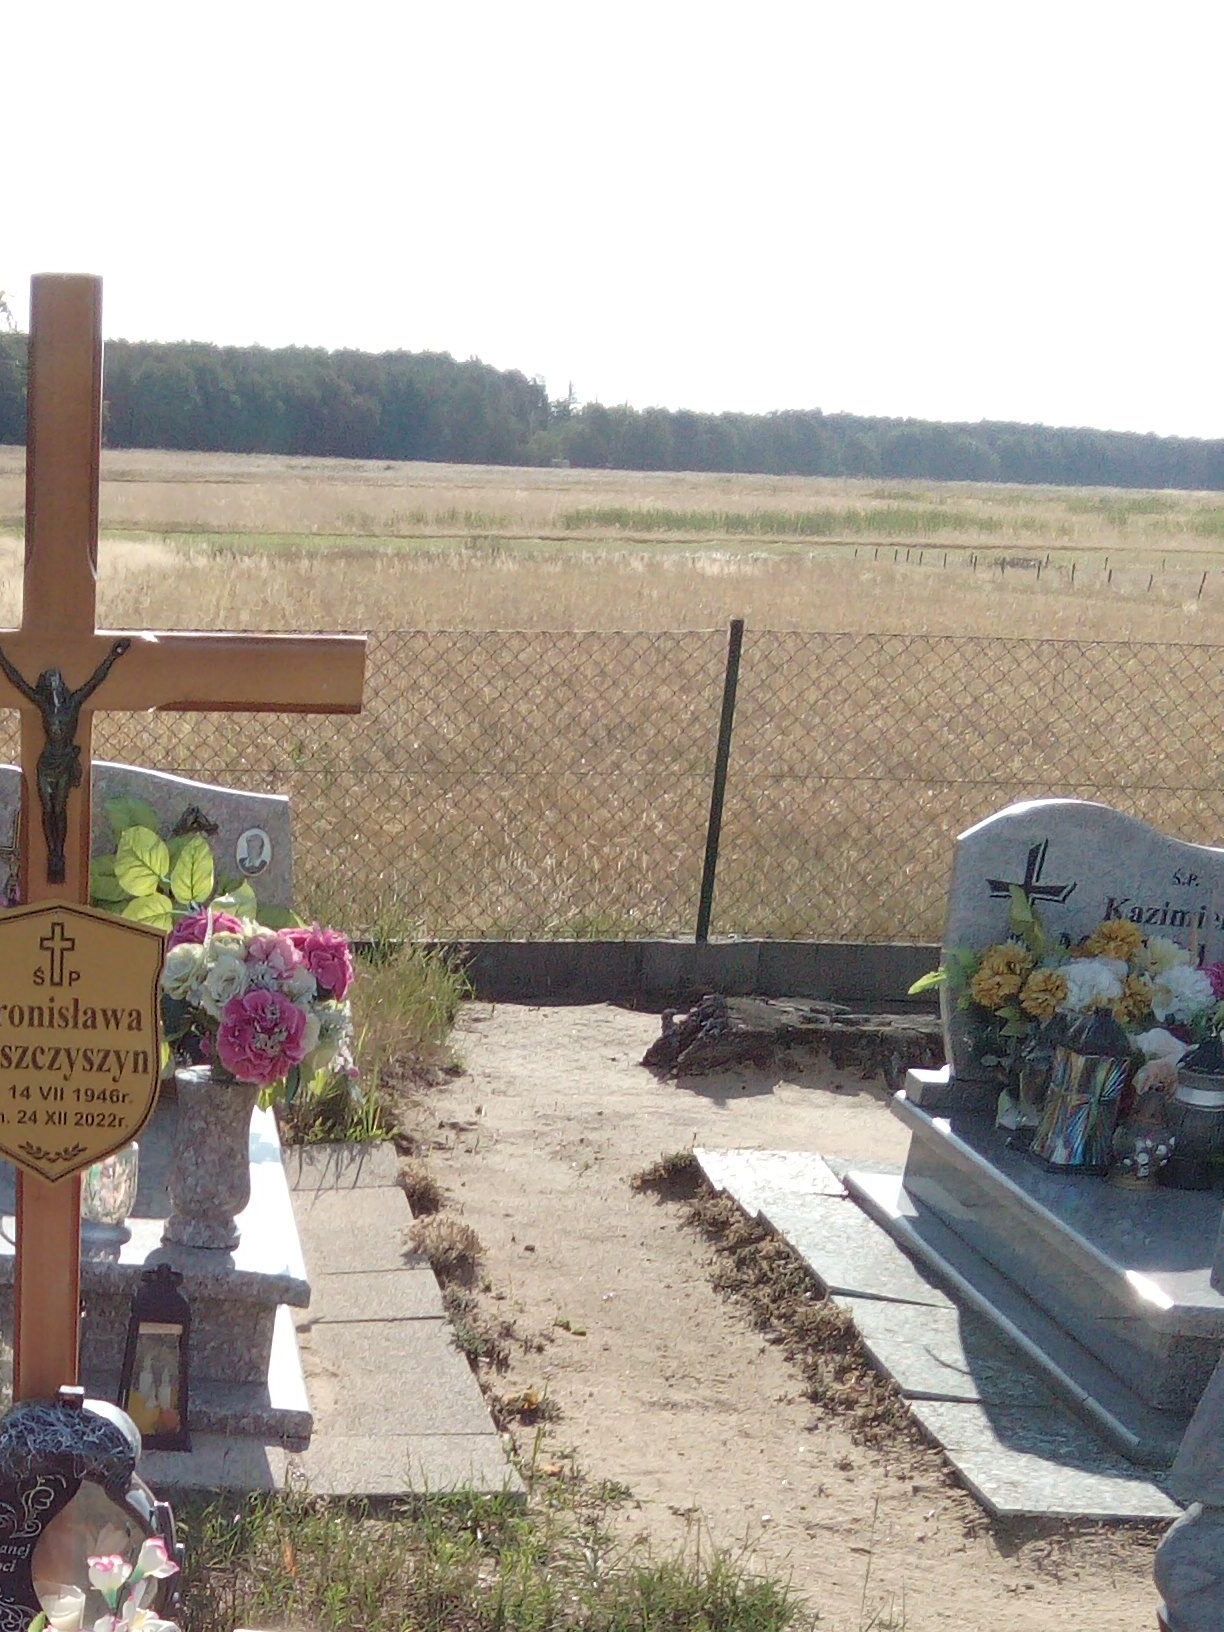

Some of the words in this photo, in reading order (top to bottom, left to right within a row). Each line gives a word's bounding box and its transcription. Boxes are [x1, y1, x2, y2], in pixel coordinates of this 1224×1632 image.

[33, 966, 45, 986] Ś
[69, 971, 80, 987] P
[8, 1085, 32, 1099] 14
[39, 1086, 64, 1101] VII
[17, 1110, 38, 1125] 24
[44, 1111, 68, 1126] XII
[74, 1112, 129, 1128] 2022r.
